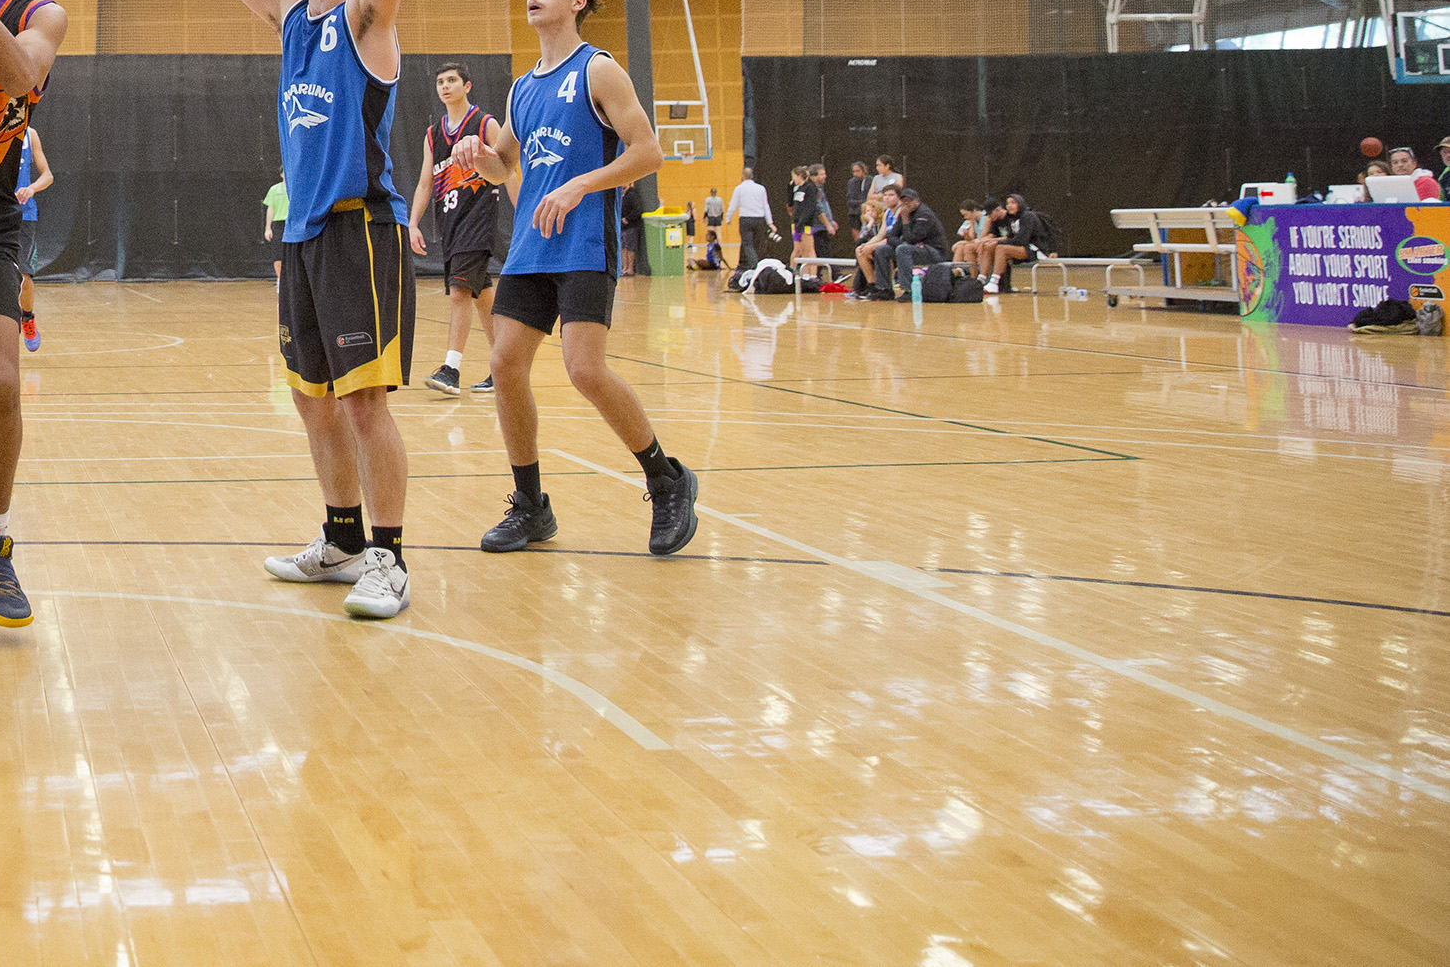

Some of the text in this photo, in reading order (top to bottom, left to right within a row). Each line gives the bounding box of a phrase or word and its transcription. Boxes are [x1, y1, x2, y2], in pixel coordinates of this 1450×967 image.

[320, 15, 338, 52] 6
[557, 71, 579, 103] 4
[443, 189, 459, 213] 33
[1289, 225, 1383, 249] IF YOU'RE SERIOUS
[1399, 244, 1445, 260] SMARTER
[1288, 253, 1391, 282] ABOUT YOUR SPORT,
[1292, 281, 1314, 305] YOU
[1315, 282, 1349, 306] WON'T
